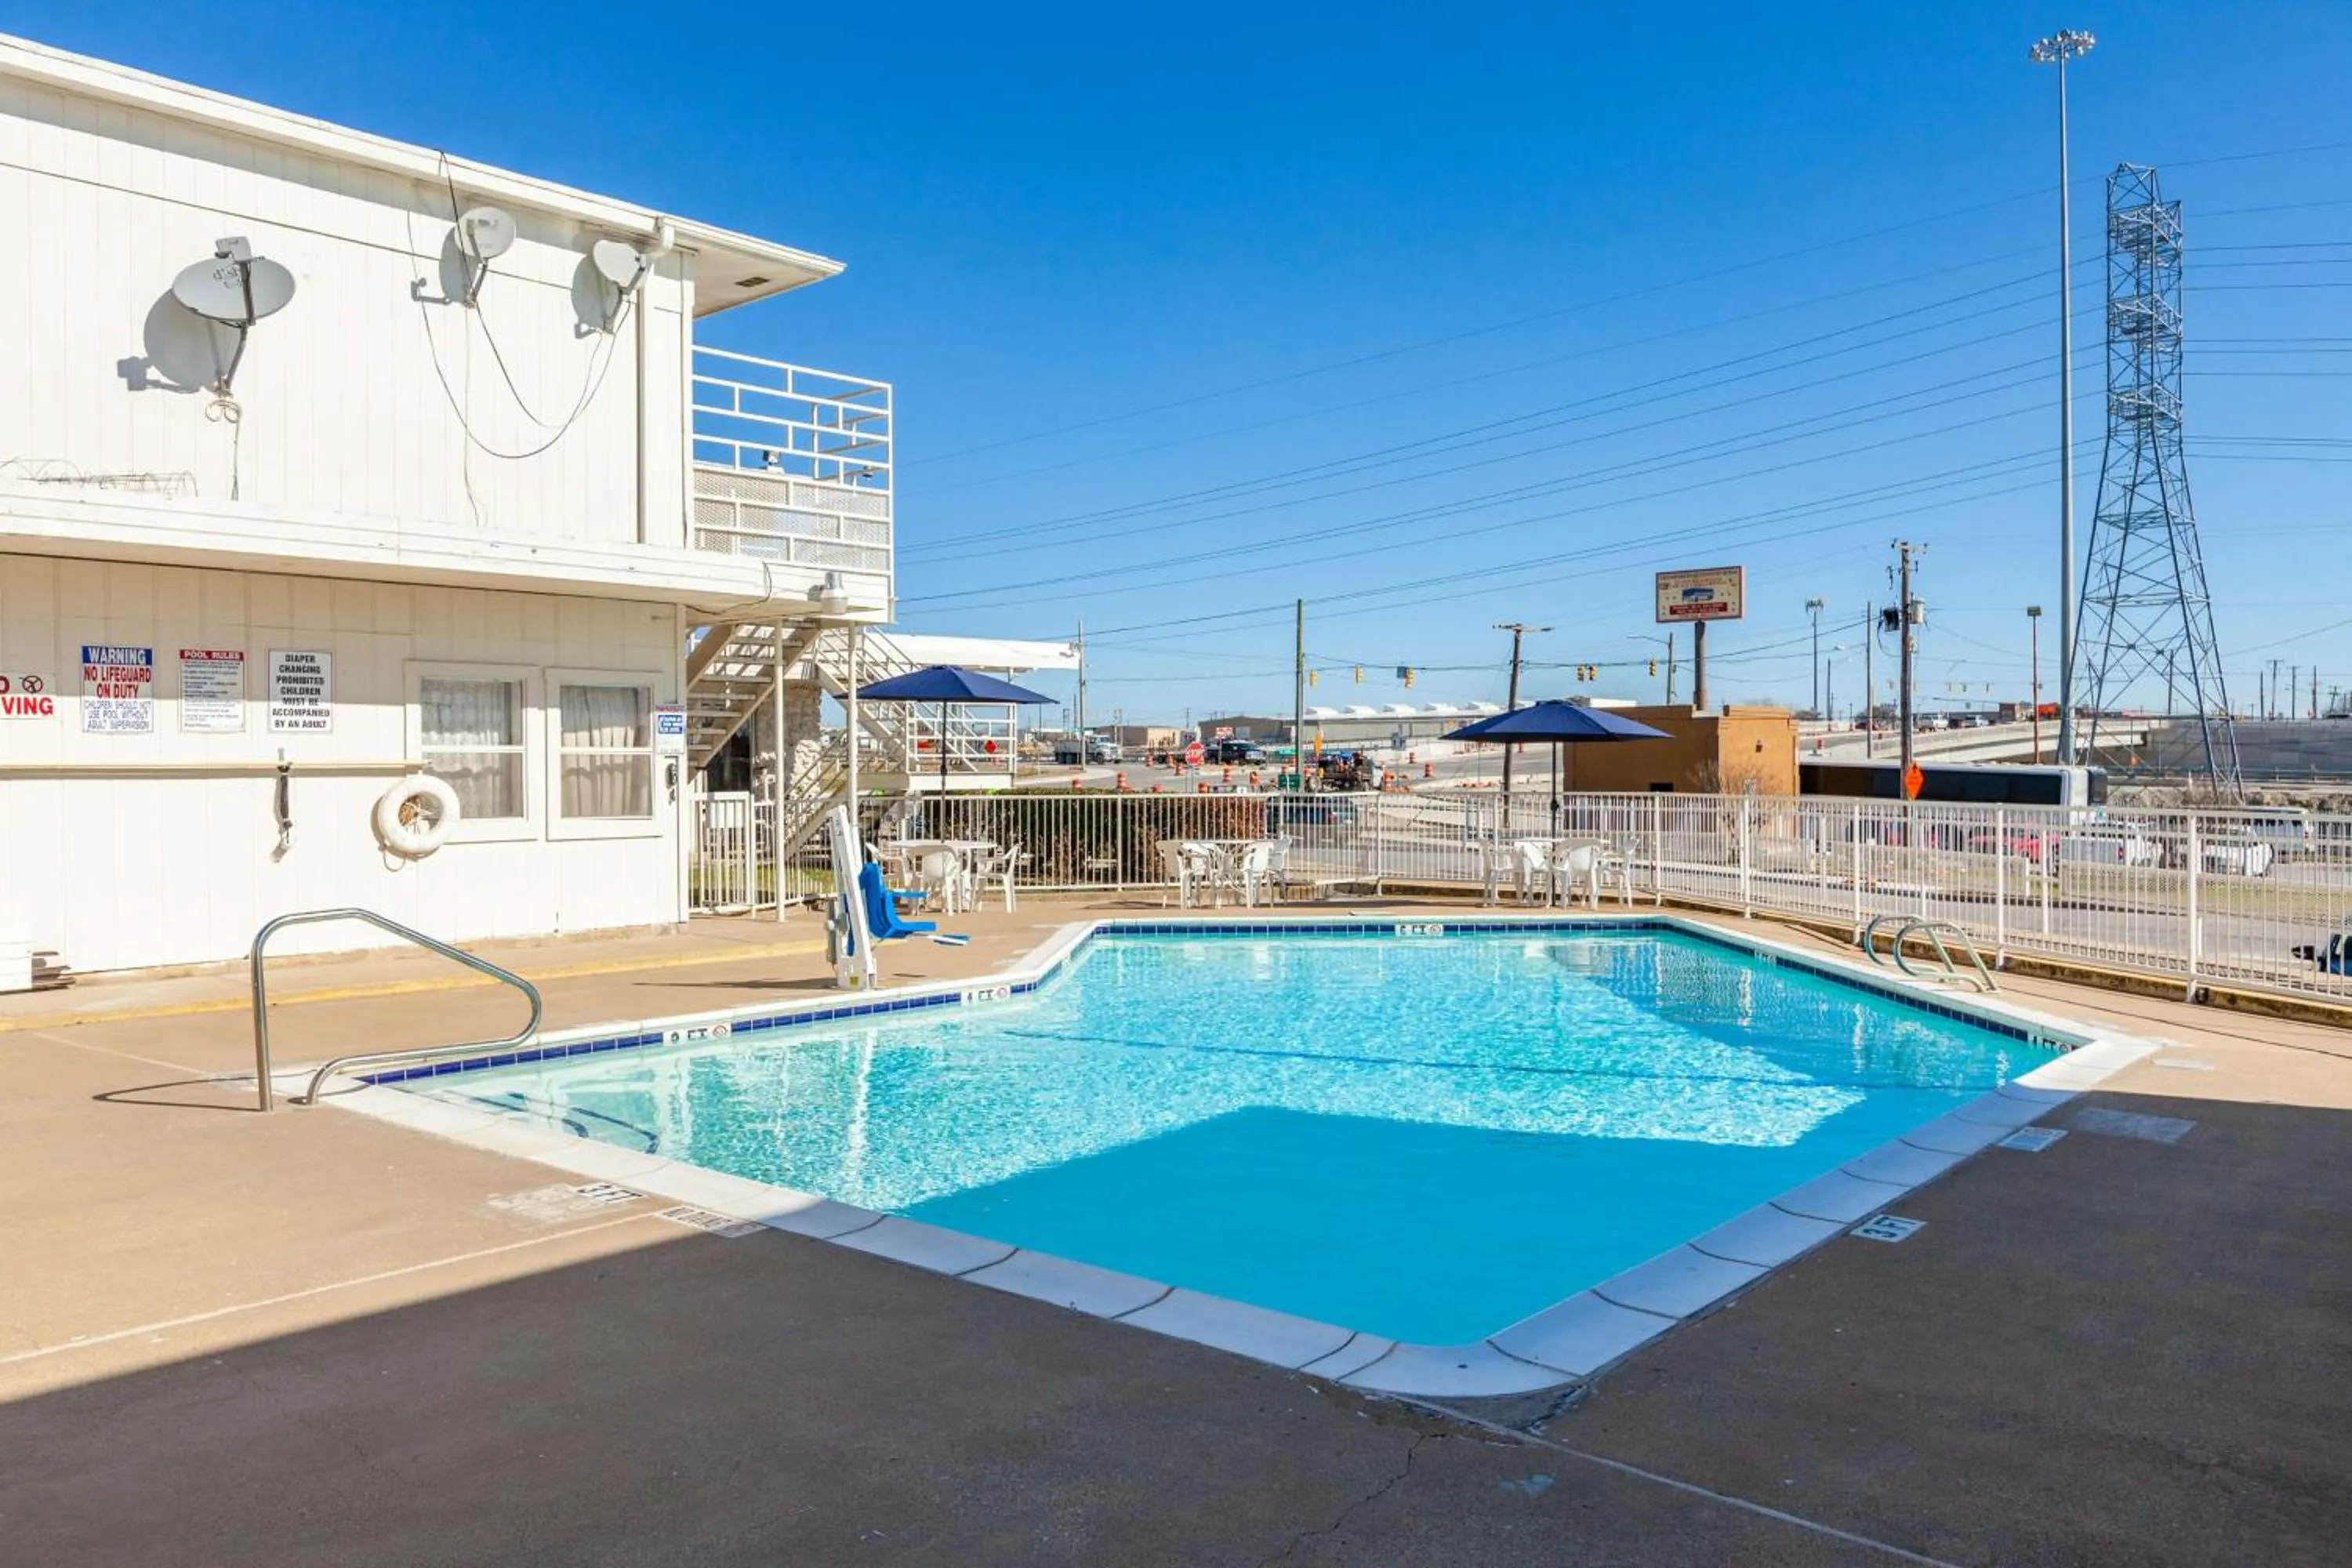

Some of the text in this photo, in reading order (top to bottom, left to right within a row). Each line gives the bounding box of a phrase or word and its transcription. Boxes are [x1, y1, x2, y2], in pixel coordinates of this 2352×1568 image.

[89, 648, 146, 664] WARNING
[285, 655, 315, 663] DIAPER
[278, 665, 321, 673] CHANGING
[84, 666, 151, 683] NO LIFEGUARD
[276, 675, 325, 685] PROHIBITED
[96, 683, 139, 699] ON DUTY
[280, 687, 321, 695] CHILDREN
[283, 697, 305, 706] MUST
[272, 708, 330, 717] ACCOMPANIED
[274, 719, 285, 728] BY
[288, 719, 299, 728] AN
[1863, 1229, 1897, 1237] 3
